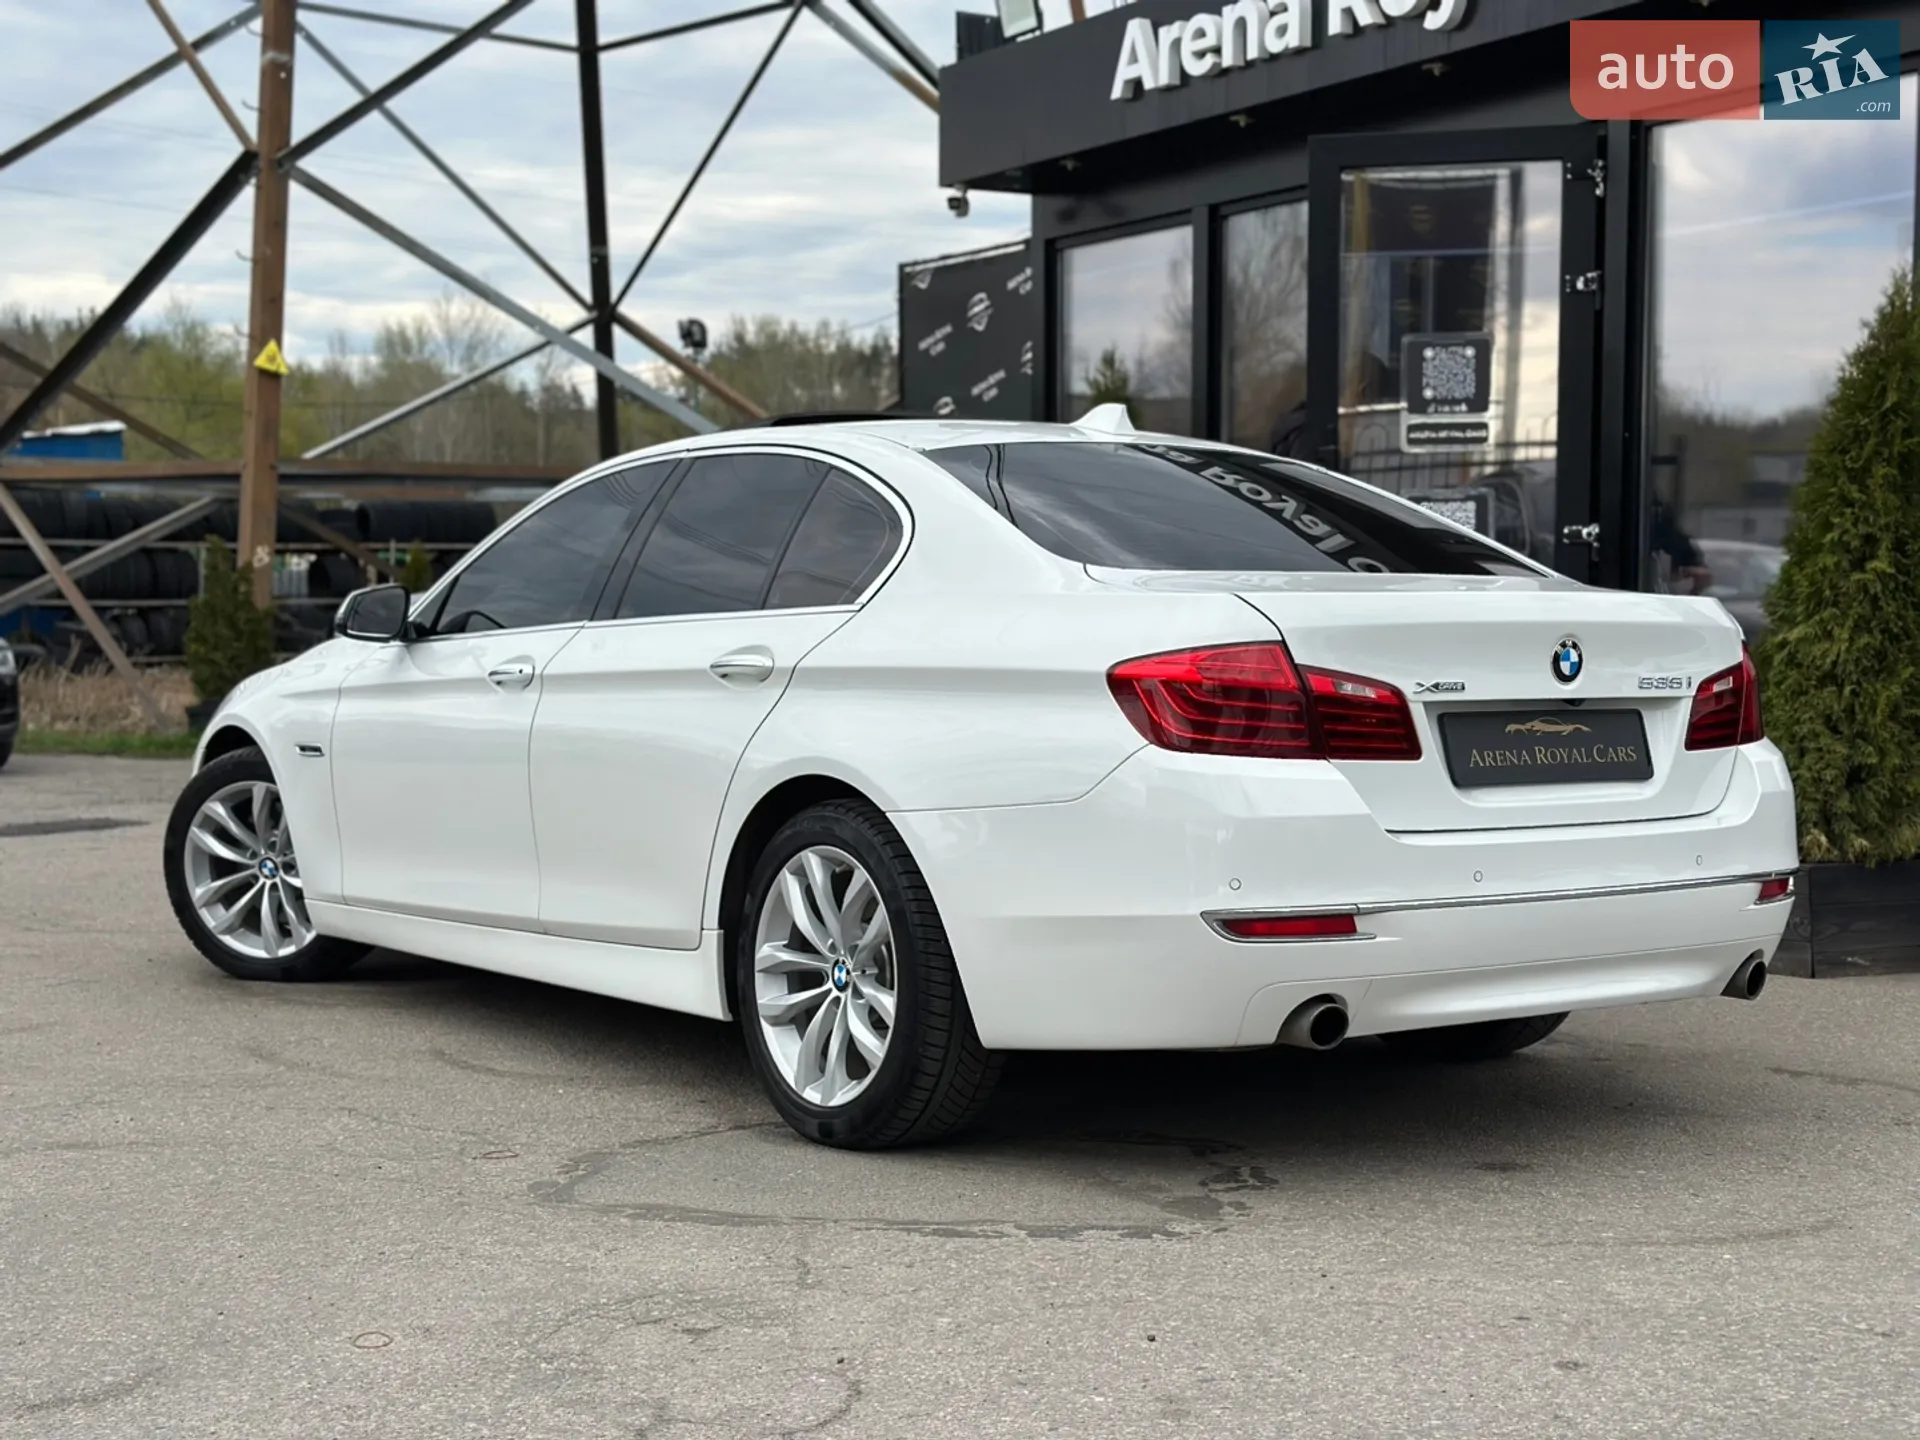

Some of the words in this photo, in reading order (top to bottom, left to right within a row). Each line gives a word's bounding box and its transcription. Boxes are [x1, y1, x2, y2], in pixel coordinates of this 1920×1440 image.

[1110, 0, 1311, 100] Arena
[1469, 749, 1532, 767] ARENA
[1534, 746, 1592, 764] ROYAL
[1593, 744, 1637, 763] CARS
